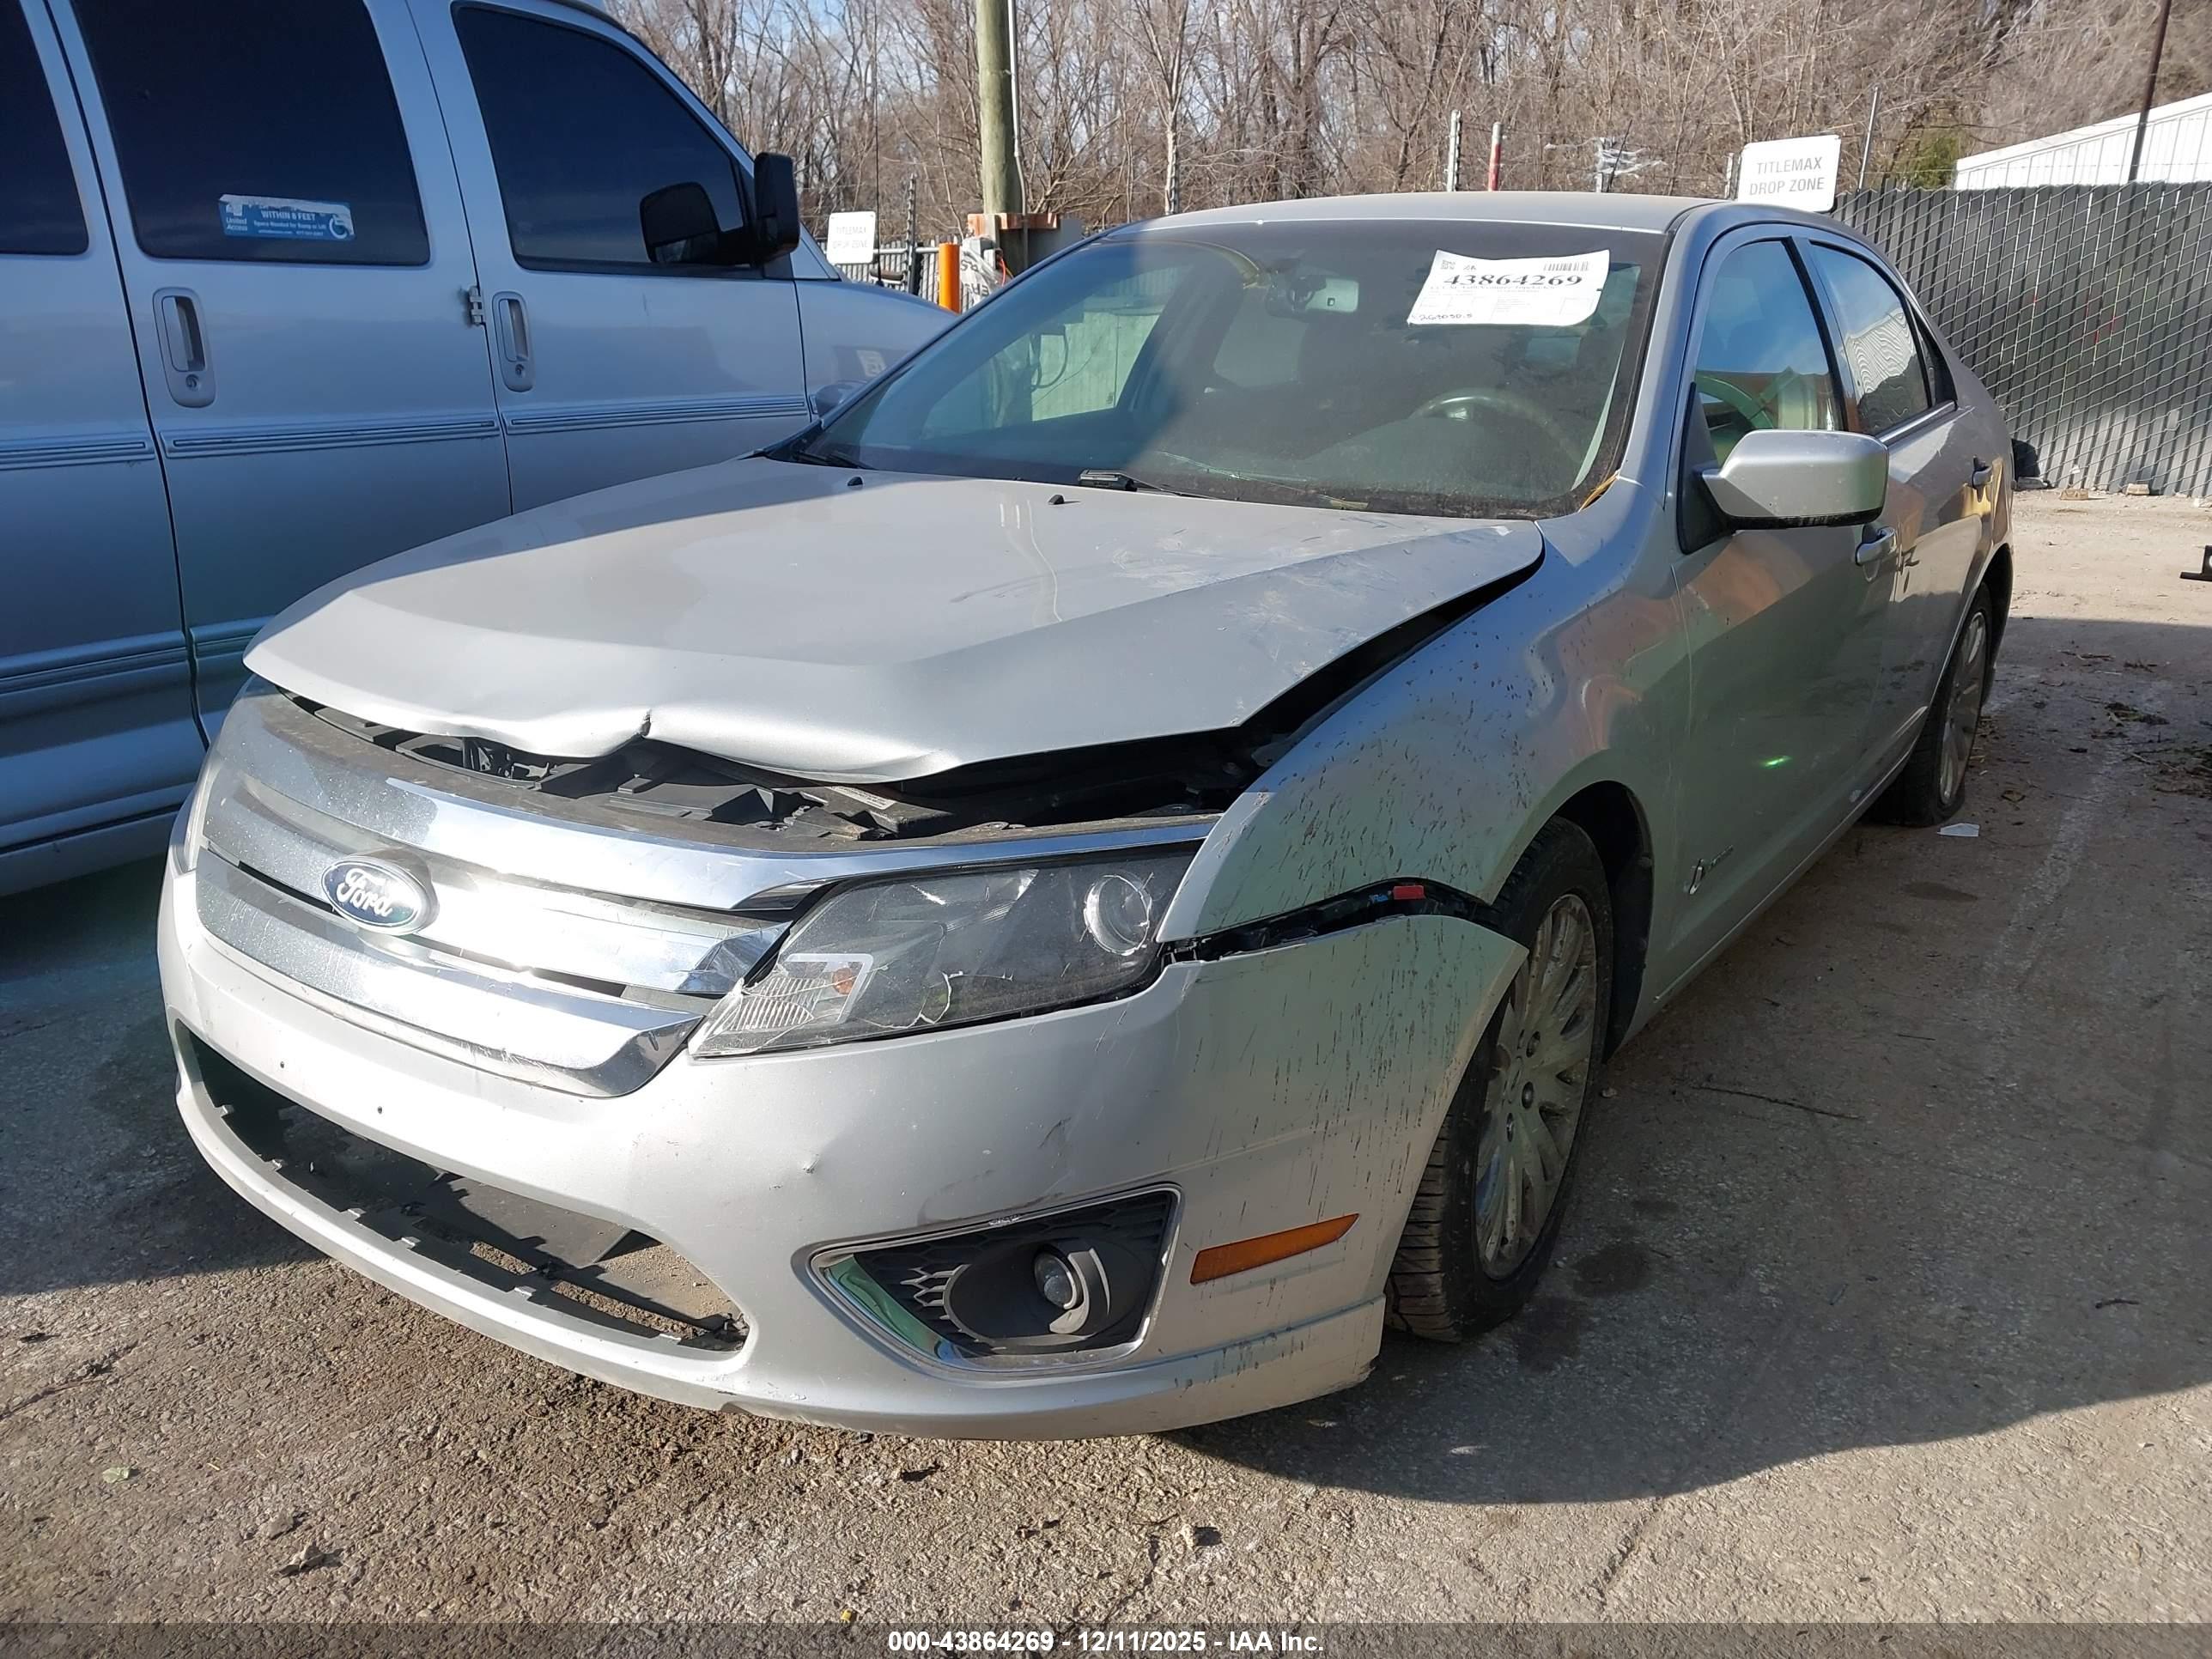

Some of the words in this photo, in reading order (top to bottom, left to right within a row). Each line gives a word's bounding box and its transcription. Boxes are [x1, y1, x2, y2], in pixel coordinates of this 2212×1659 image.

[1757, 156, 1822, 174] TITLEMAX
[1749, 180, 1785, 195] DROP
[1789, 177, 1825, 191] ZONE
[261, 210, 290, 220] WITHIN
[298, 212, 316, 221] FEET
[1443, 274, 1583, 286] 43864269
[336, 867, 393, 917] Ford
